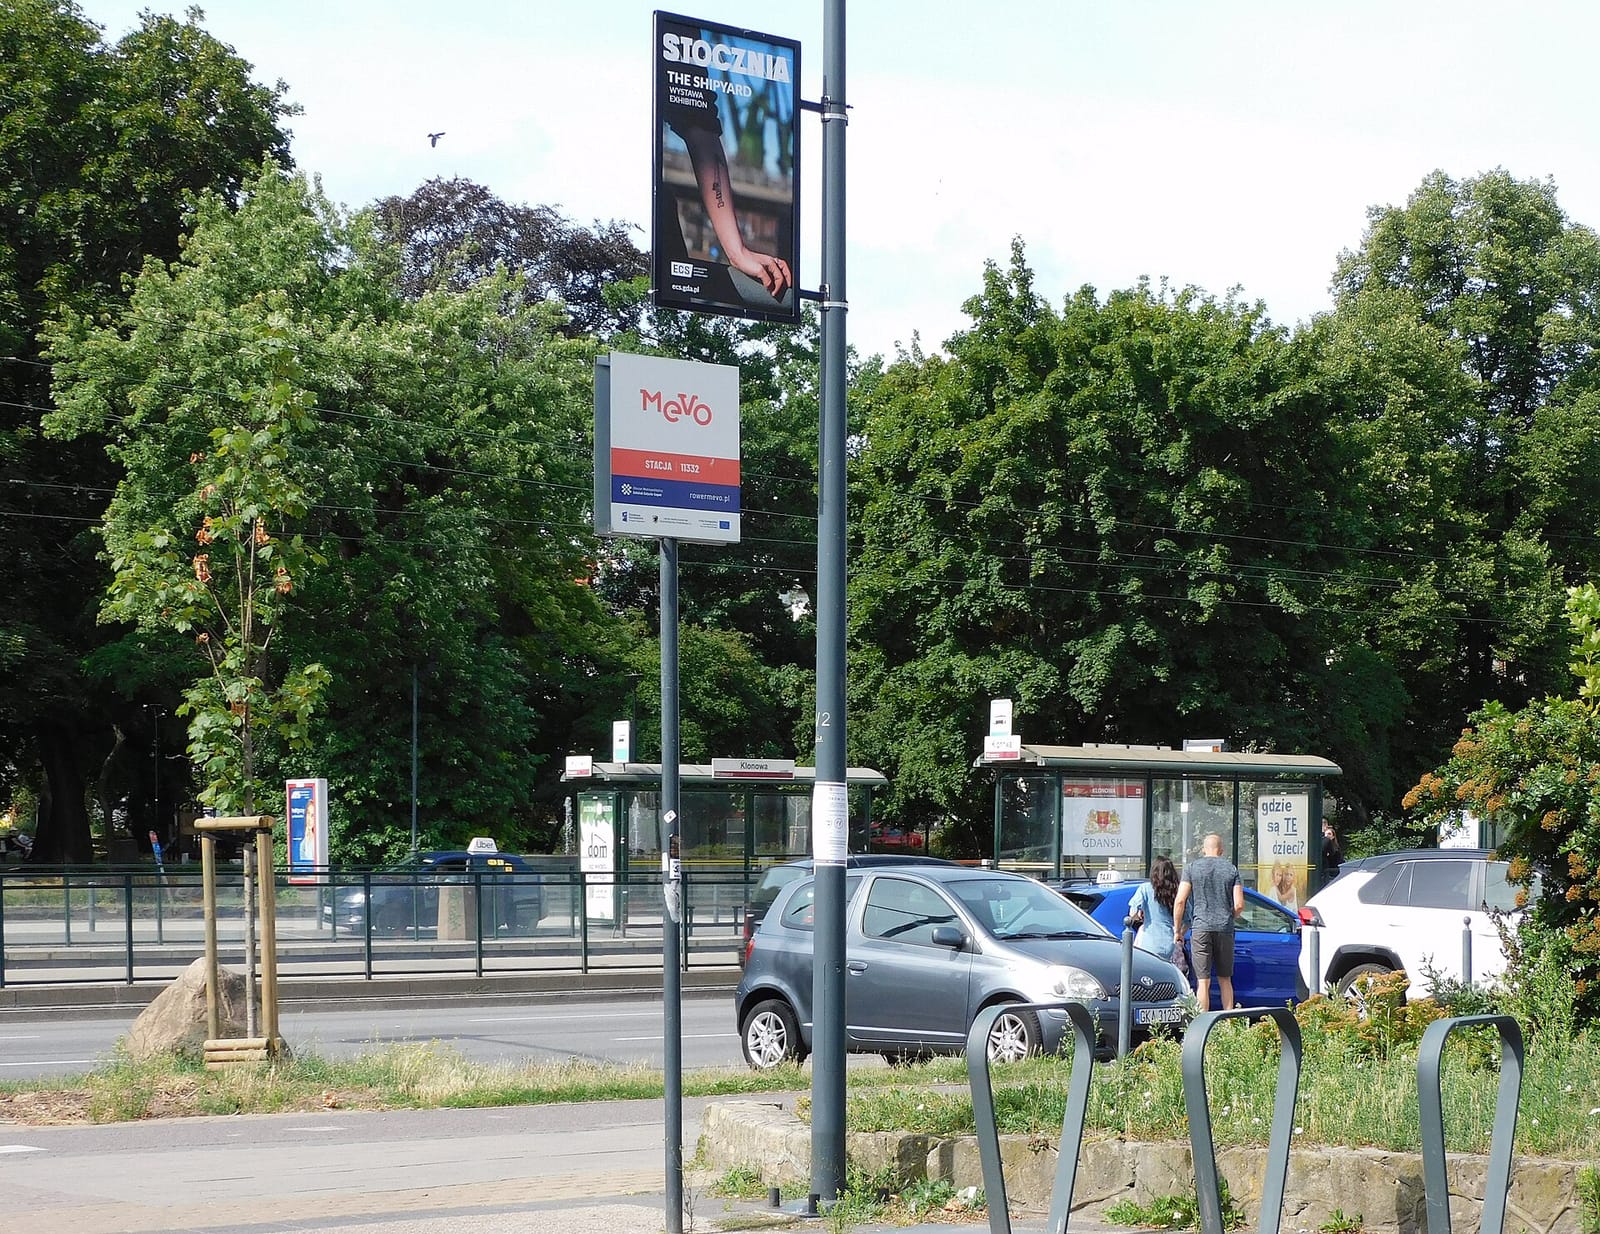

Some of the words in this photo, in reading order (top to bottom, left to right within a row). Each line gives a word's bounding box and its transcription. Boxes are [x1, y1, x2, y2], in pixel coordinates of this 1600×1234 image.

[662, 33, 790, 83] STOCZNIA
[667, 70, 691, 88] THE
[693, 75, 752, 97] SHIPYARD
[669, 86, 704, 99] WYSTAWA
[669, 95, 708, 109] EXHIBITION
[671, 284, 700, 294] ecs.gda.pl
[645, 459, 673, 471] STACJA
[680, 463, 700, 474] 11332
[689, 492, 730, 502] rowermevo.pl
[740, 761, 768, 770] Klonowa
[1261, 798, 1292, 816] gdzie
[1267, 821, 1280, 836] są
[1284, 817, 1298, 833] TE
[476, 840, 494, 849] Uber
[587, 833, 608, 858] dom
[1272, 840, 1304, 855] dzieci?
[1140, 1010, 1156, 1023] GKA
[1158, 1008, 1180, 1022] 31255
